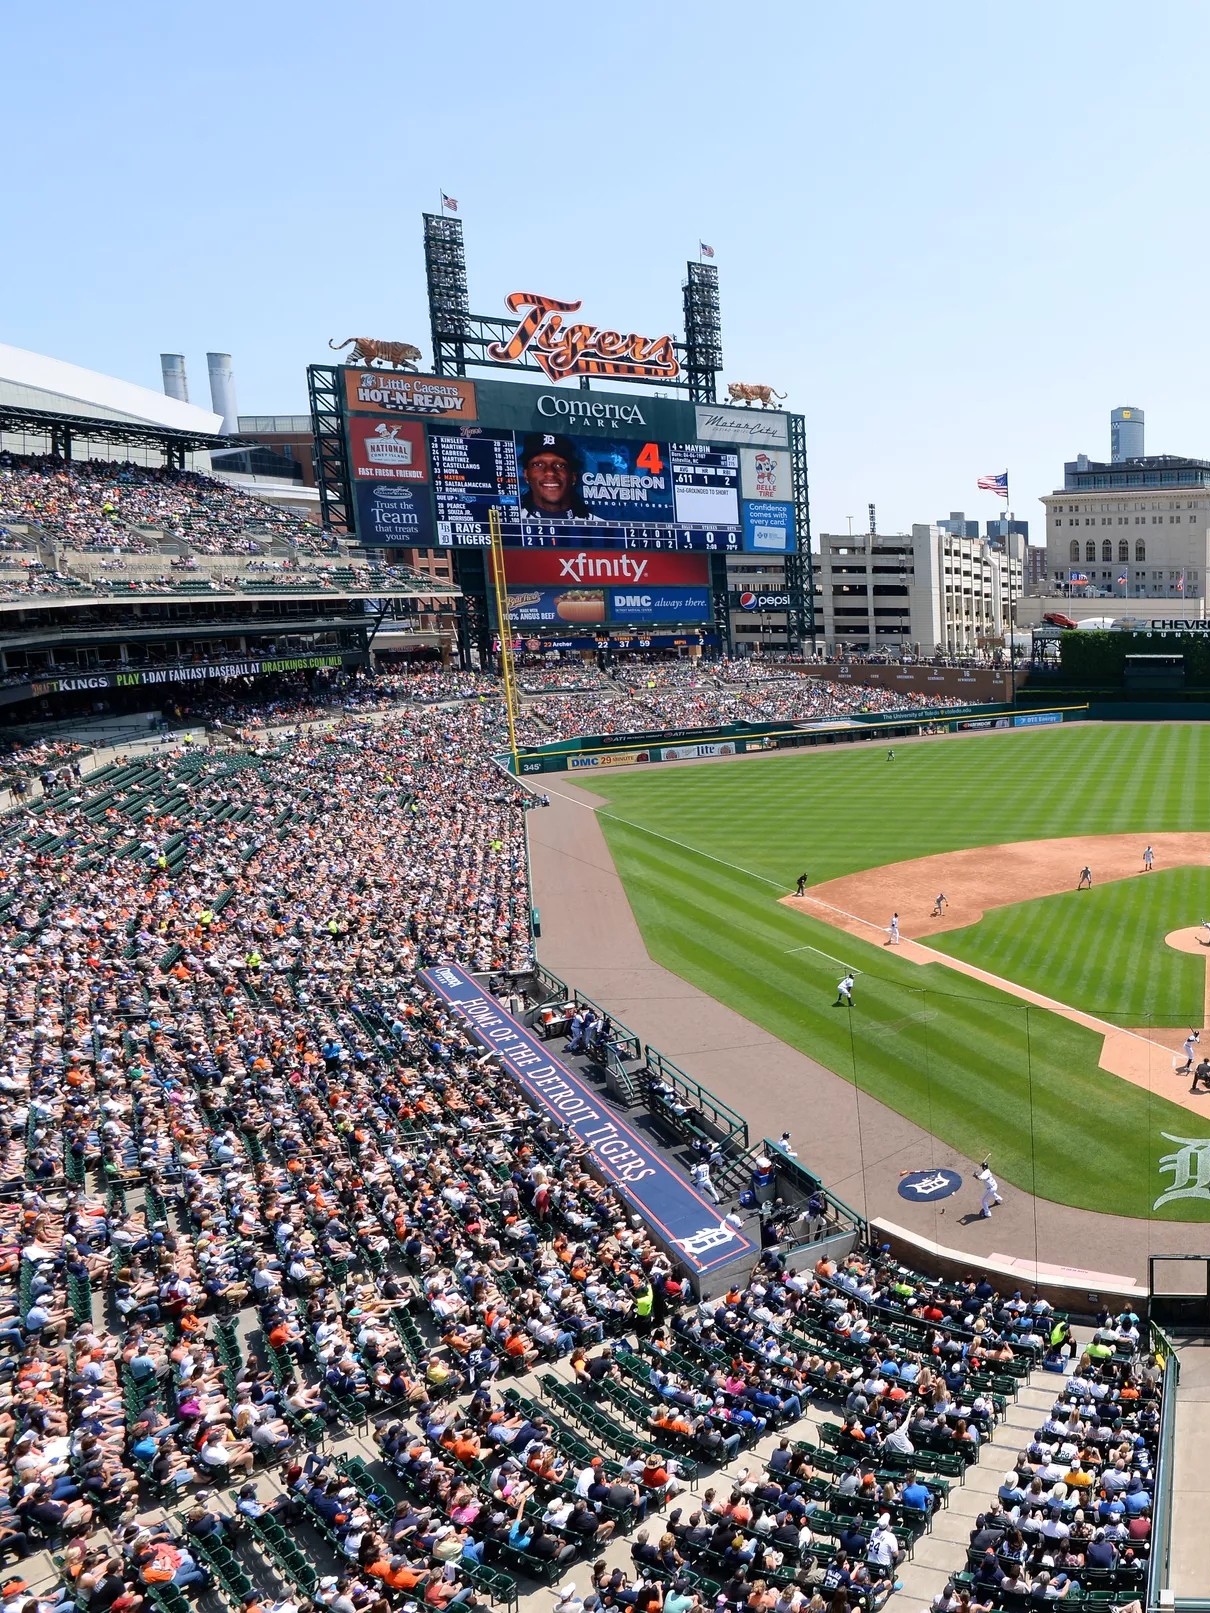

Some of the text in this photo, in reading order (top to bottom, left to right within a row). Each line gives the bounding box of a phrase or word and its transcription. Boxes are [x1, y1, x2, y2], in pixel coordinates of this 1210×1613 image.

[487, 292, 680, 384] Tigers
[380, 377, 458, 396] Little Caesars
[358, 388, 465, 411] HOT-N-READY
[386, 404, 440, 413] PIZZA
[569, 416, 619, 429] PARK
[370, 444, 408, 455] NATIONAL
[441, 443, 468, 451] MARTINEZ
[684, 444, 711, 453] MAYBIN
[636, 443, 663, 474] 4
[443, 462, 481, 470] CASTELLANOS
[444, 481, 492, 489] SALTALAMACCHIA
[582, 472, 666, 490] CAMERON
[675, 474, 730, 486] .611 2
[582, 485, 648, 501] MAYBIN
[756, 484, 777, 492] BELLE
[759, 490, 774, 498] TIRE
[374, 501, 414, 510] Trust the
[749, 503, 787, 512] Confidence
[371, 508, 419, 524] Team
[772, 511, 788, 519] with
[750, 518, 767, 526] every
[375, 525, 419, 533] that treats
[455, 523, 482, 533] RAYS
[526, 526, 544, 535] 0 2
[642, 529, 648, 538] 4
[684, 531, 736, 544] 1 0 0
[457, 535, 492, 545] TIGERS
[559, 552, 648, 582] xfinity
[614, 595, 707, 609] DMC always there.
[758, 594, 790, 607] pepsi
[116, 672, 140, 687] PLAY
[141, 669, 168, 684] 1-DAY
[168, 667, 206, 681] FANTASY
[209, 664, 249, 678] BASEBALL
[251, 662, 260, 674] AT
[261, 655, 342, 673] DRAFTKINGS.COM/MLB
[893, 712, 918, 720] University
[1039, 715, 1059, 725] Energy
[571, 757, 599, 768] DMC
[601, 756, 612, 765] 29
[463, 997, 656, 1183] HOME OF THE DETROIT TIGERS
[869, 1539, 881, 1554] 24
